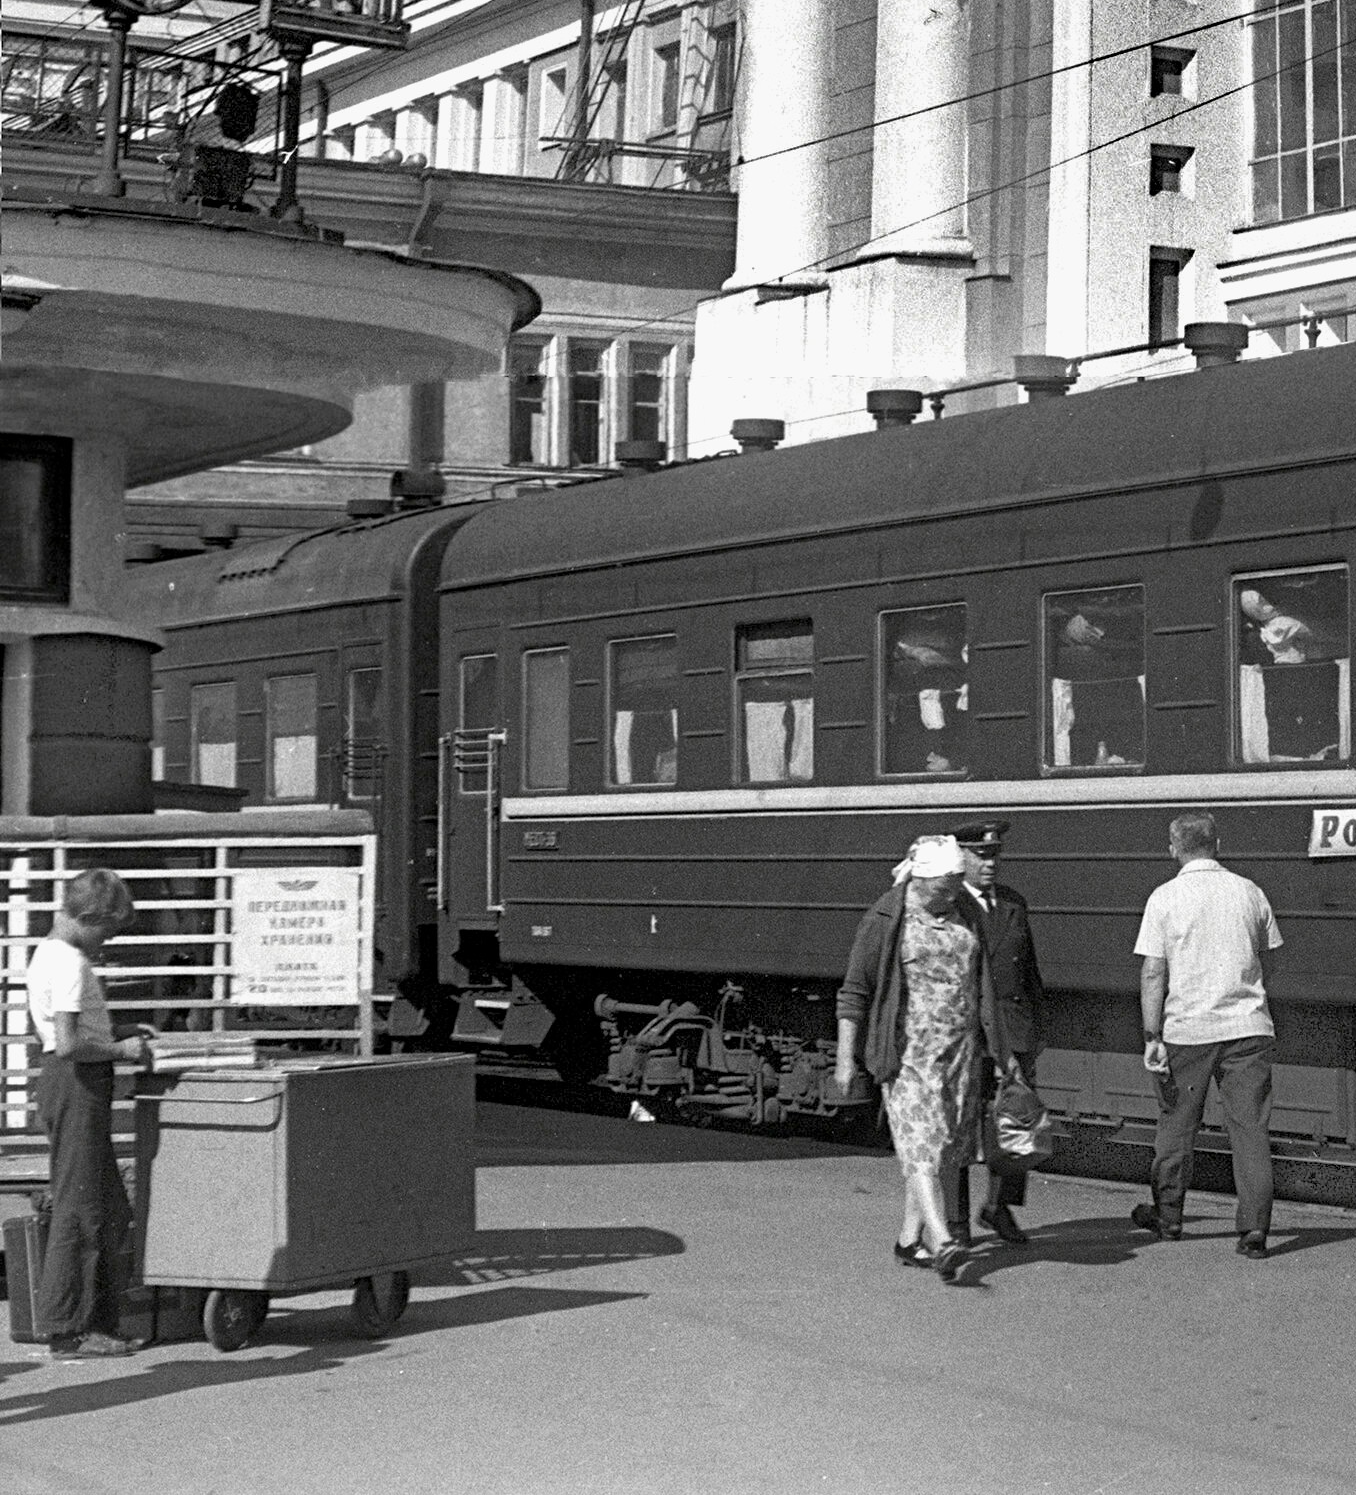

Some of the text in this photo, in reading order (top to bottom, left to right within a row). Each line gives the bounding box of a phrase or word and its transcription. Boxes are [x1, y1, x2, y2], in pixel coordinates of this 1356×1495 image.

[247, 900, 346, 913] ПЕРЕДВИЖНАЯ
[269, 917, 325, 929] КАМЕРА
[260, 934, 333, 946] ХРАНЕНИЯ
